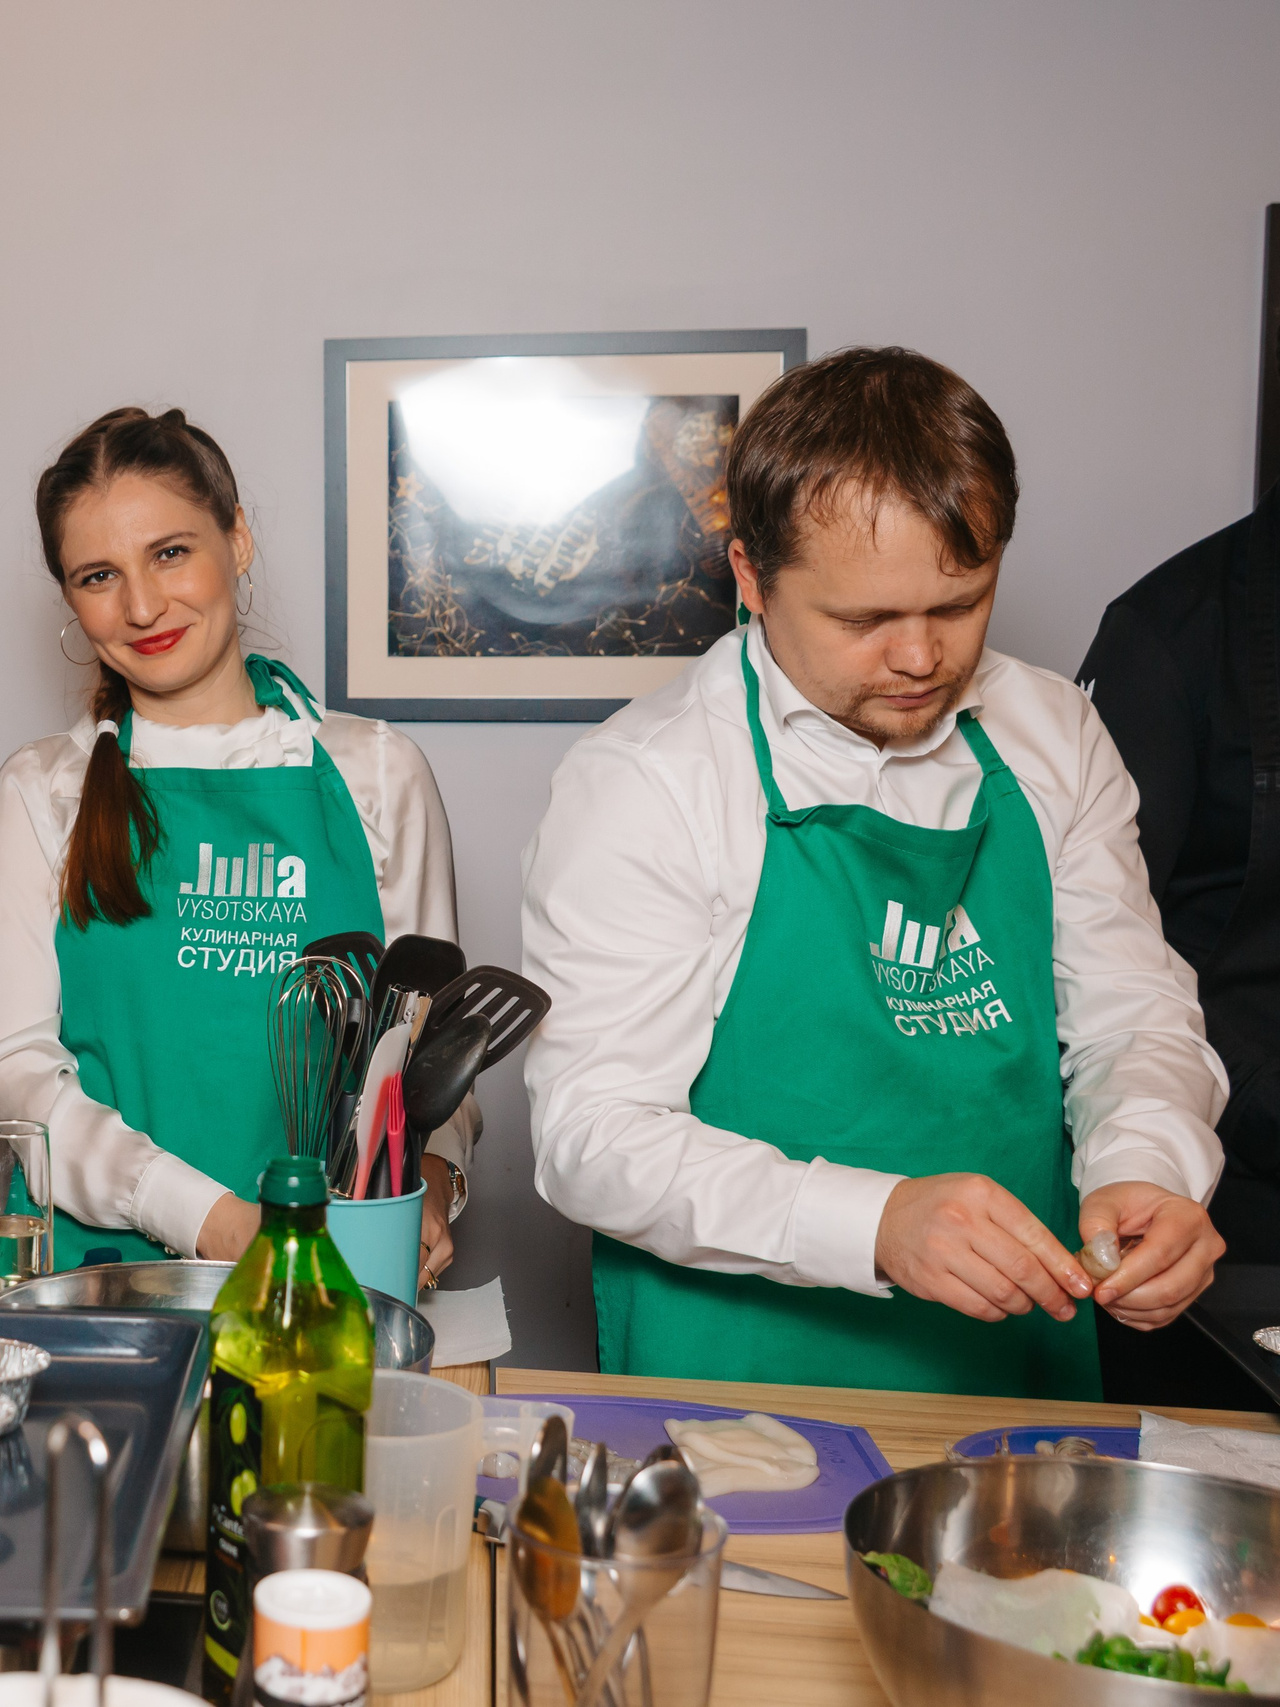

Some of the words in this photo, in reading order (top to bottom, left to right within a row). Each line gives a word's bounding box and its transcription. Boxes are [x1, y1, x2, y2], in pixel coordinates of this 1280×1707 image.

[179, 843, 306, 898] Julia
[177, 898, 307, 923] VYSOTSKAYA
[180, 927, 297, 947] КУЛИНАРНАЯ
[869, 900, 981, 969] Jua
[177, 946, 297, 977] СТУДИЯ
[885, 980, 997, 1012] КУЛИНАРНАЯ
[894, 998, 1013, 1037] СТУДИЯ
